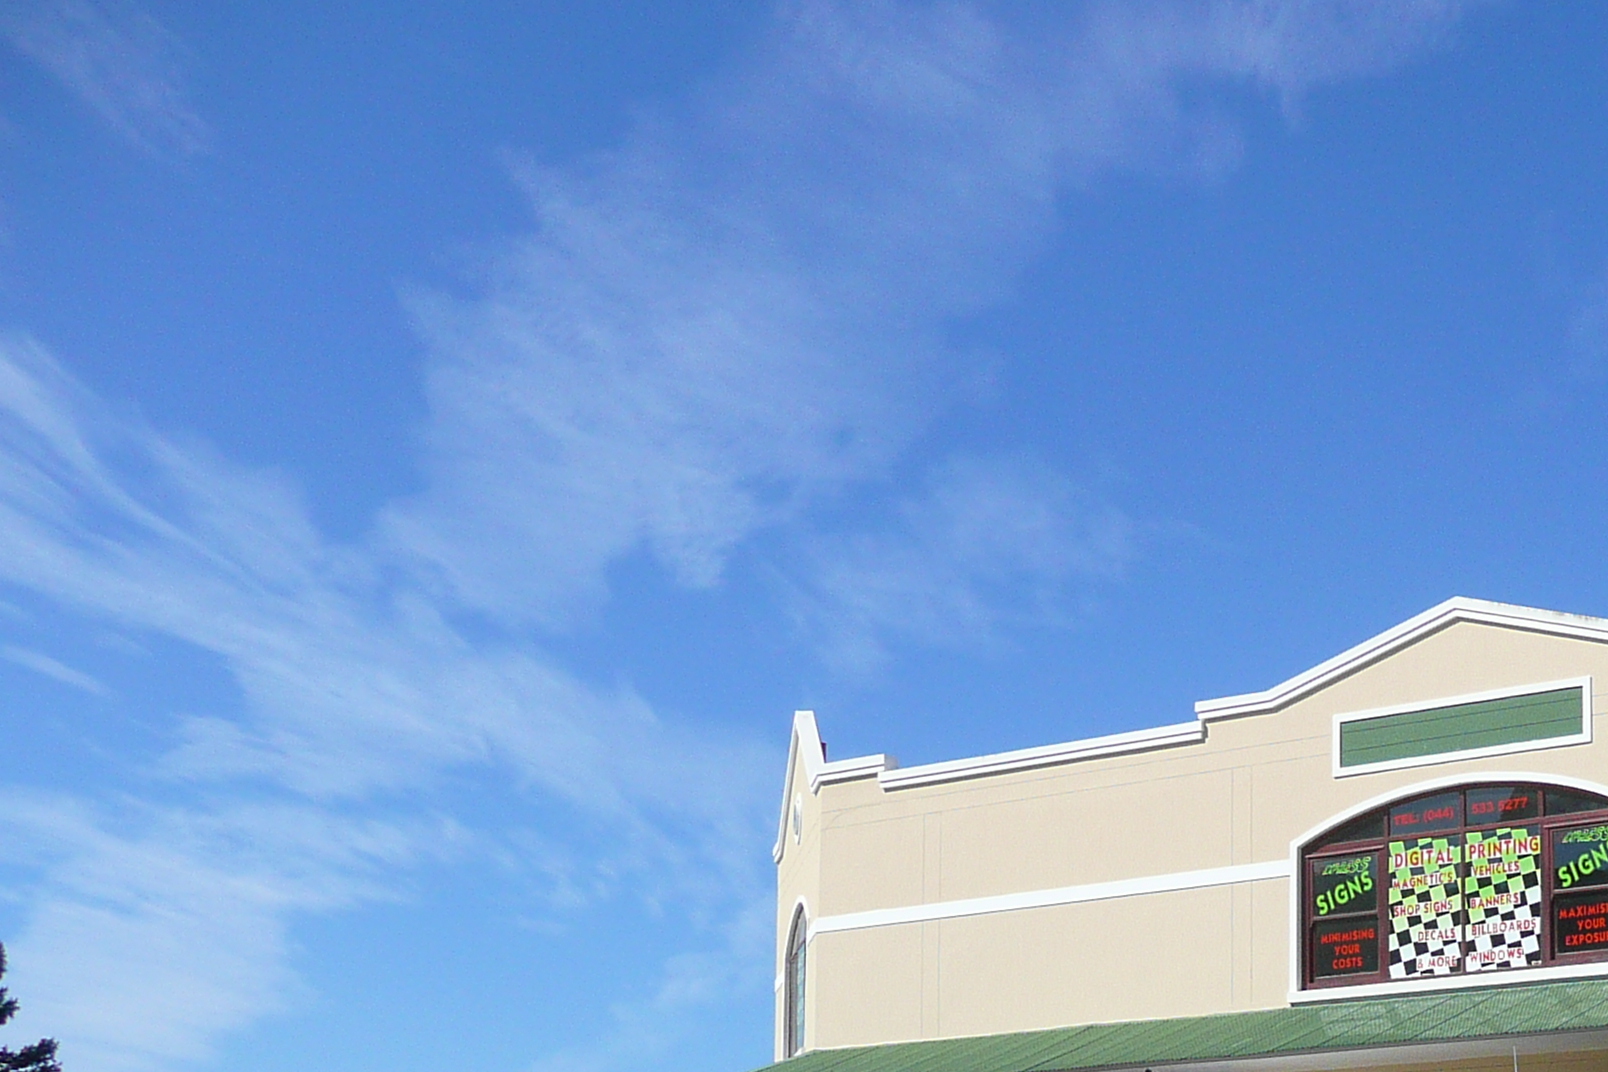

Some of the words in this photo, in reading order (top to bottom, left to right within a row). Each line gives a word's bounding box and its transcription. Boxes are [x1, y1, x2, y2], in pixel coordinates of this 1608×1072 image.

[1394, 848, 1453, 868] DIGITAL
[1469, 836, 1539, 859] PRINTING
[1473, 860, 1520, 876] VEHICLES
[1393, 871, 1453, 889] MAGNETIC'S
[1316, 871, 1373, 915] SIGNS
[1470, 893, 1519, 909] BANNERS
[1394, 903, 1420, 917] SHOP
[1423, 899, 1453, 914] SIGNS
[1471, 918, 1537, 936] BILLBOARDS
[1577, 917, 1606, 930] YOUR
[1321, 928, 1375, 944] MINIMISING
[1418, 927, 1456, 941] DECALS
[1334, 944, 1360, 955] YOUR
[1470, 947, 1524, 963] WINDOWS
[1332, 957, 1363, 969] COSTS
[1428, 955, 1457, 968] MORE
